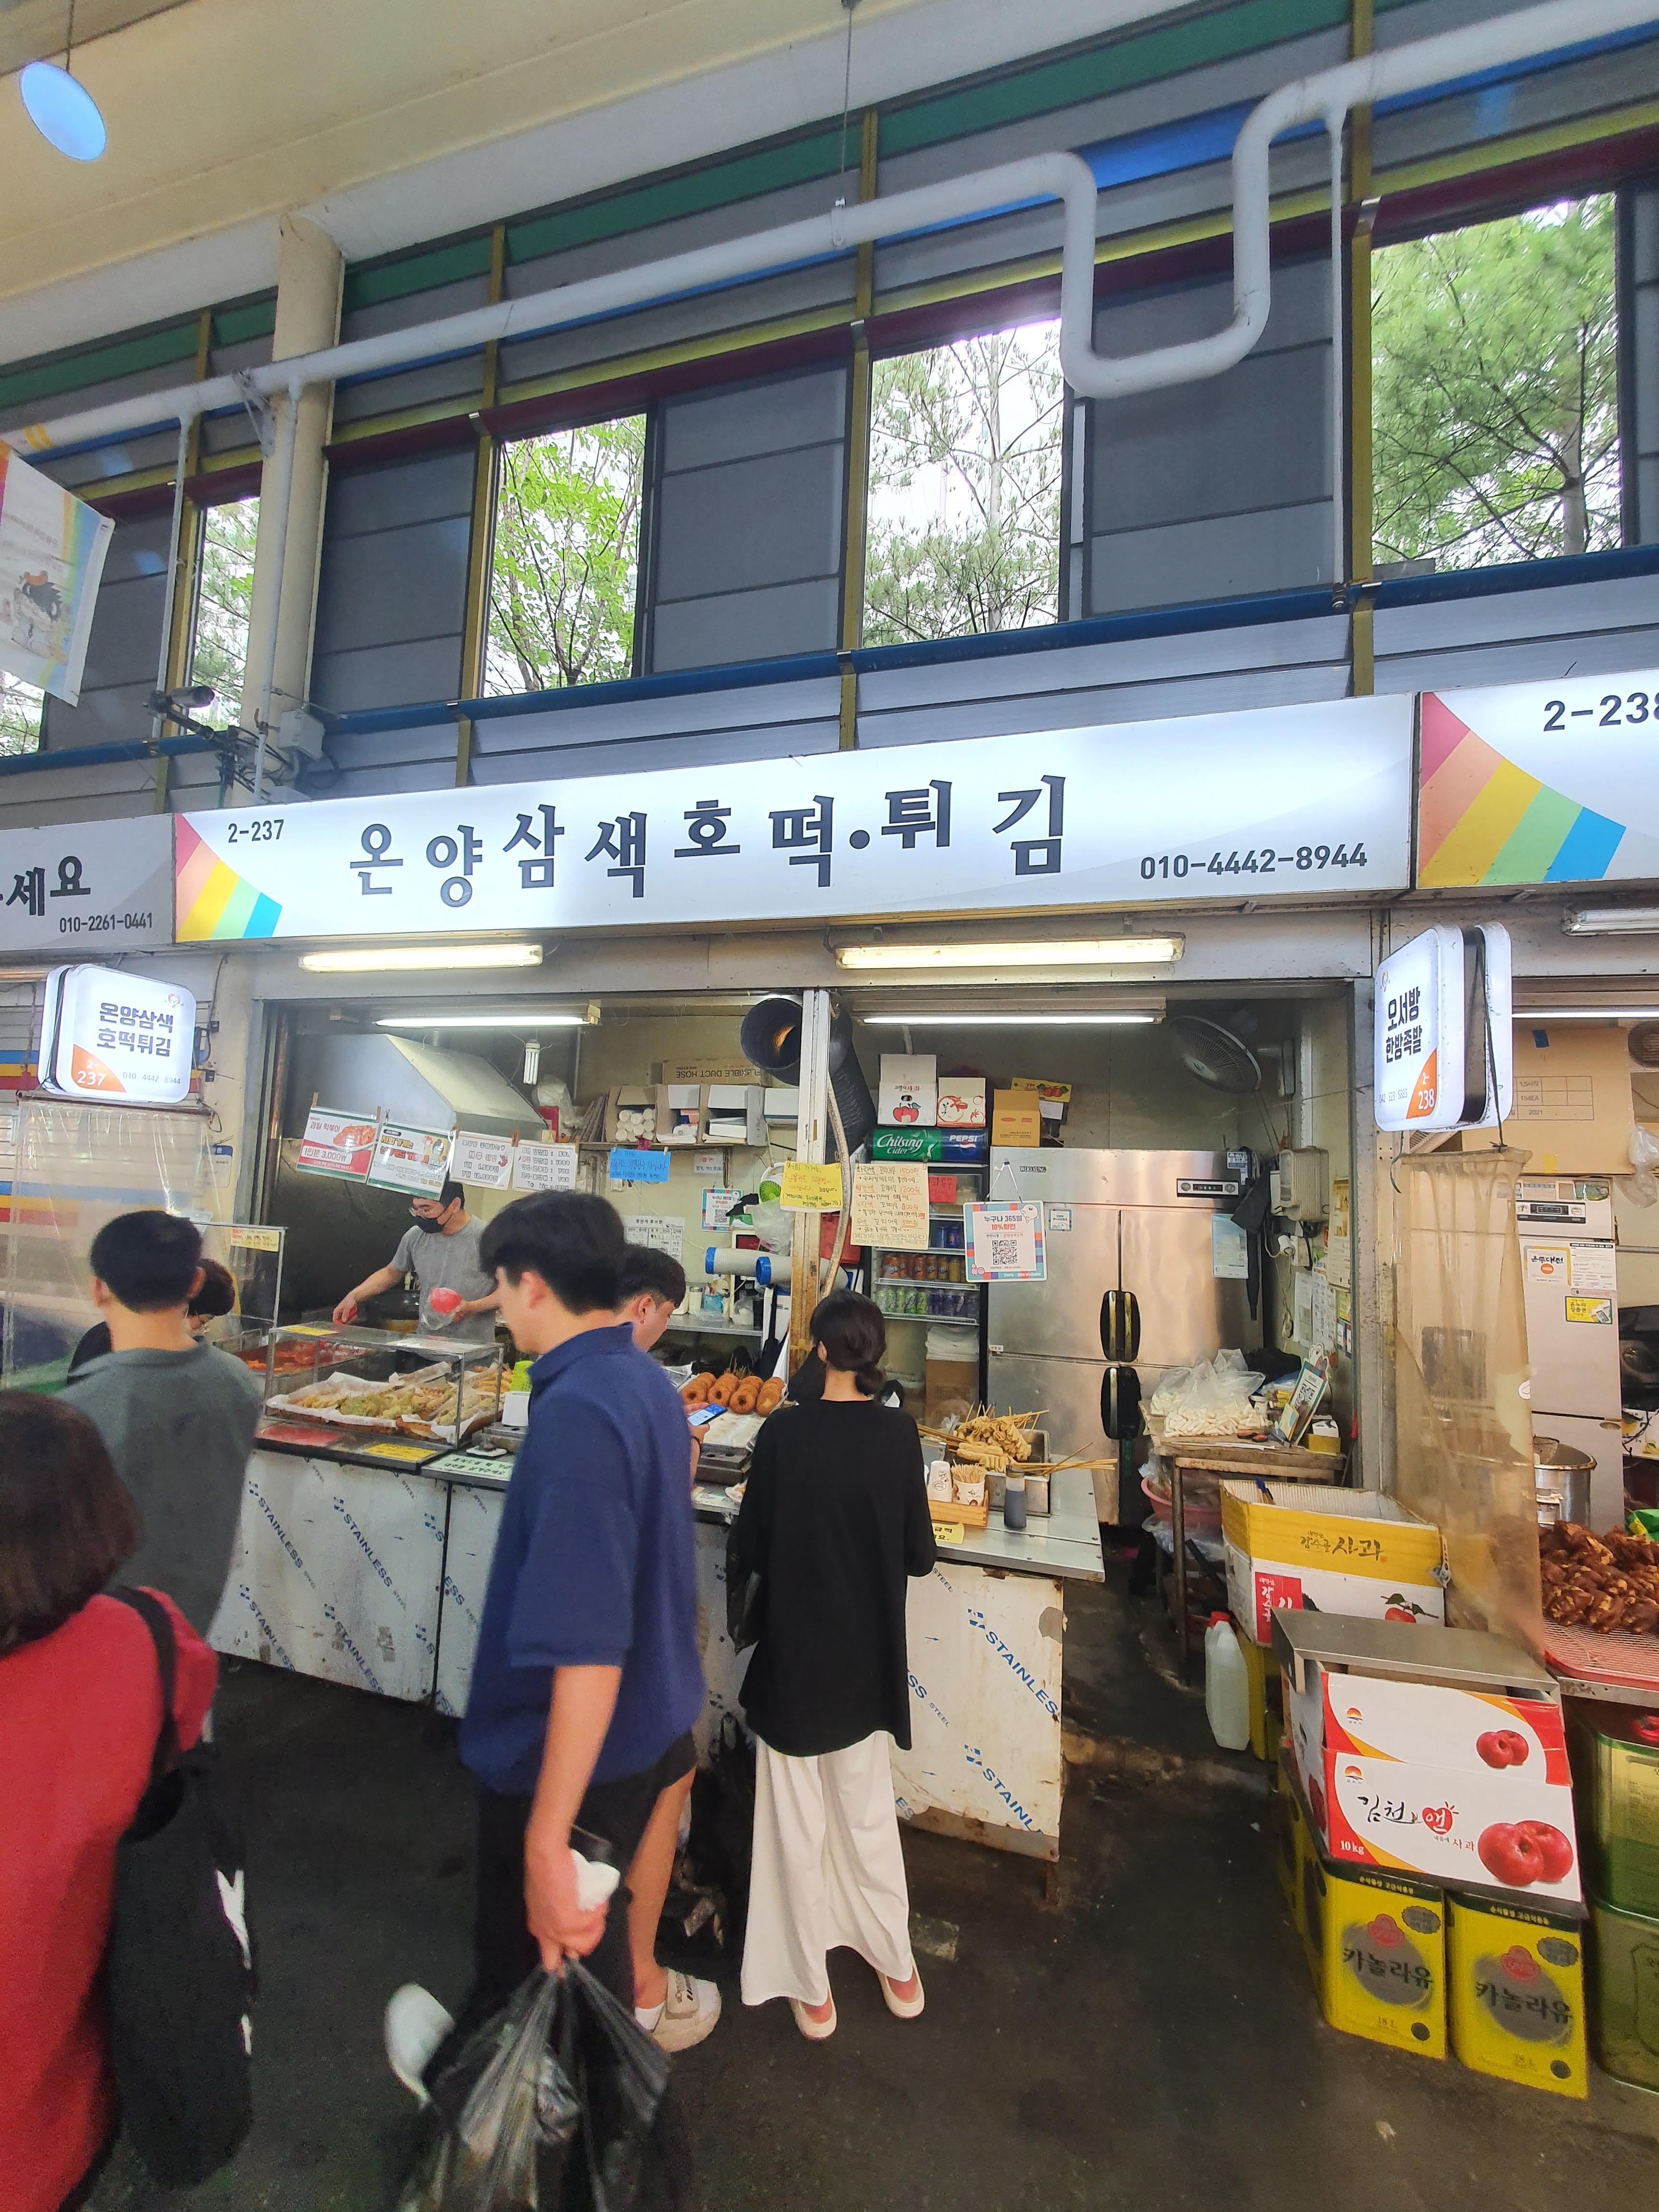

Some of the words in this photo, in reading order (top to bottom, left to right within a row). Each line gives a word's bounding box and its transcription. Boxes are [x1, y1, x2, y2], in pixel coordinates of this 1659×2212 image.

[1543, 692, 1659, 732] 2-23
[228, 819, 285, 843] 2-237
[1141, 842, 1367, 880] 010-4442-8944
[0, 855, 91, 917] 세요
[59, 913, 153, 933] 010-2261-0441
[99, 1002, 174, 1033] 온양삼색
[1388, 986, 1420, 1032] 오서방
[97, 1028, 171, 1057] 호떡튀김
[1386, 1025, 1422, 1063] 한방족발
[77, 1070, 107, 1086] 237
[1418, 1088, 1435, 1110] 238
[258, 1496, 304, 1569] STAINLESS
[343, 1513, 393, 1588] STAINLESS
[1332, 1536, 1384, 1561] 사과
[932, 1568, 953, 1593] STEEL
[986, 1631, 1060, 1716] STAINLES
[929, 1702, 950, 1728] STEEL
[1357, 1793, 1405, 1824] 김천
[1452, 1838, 1475, 1851] 사과
[1343, 1947, 1435, 1990] 카놀라유
[1475, 1981, 1573, 2024] 카놀라유
